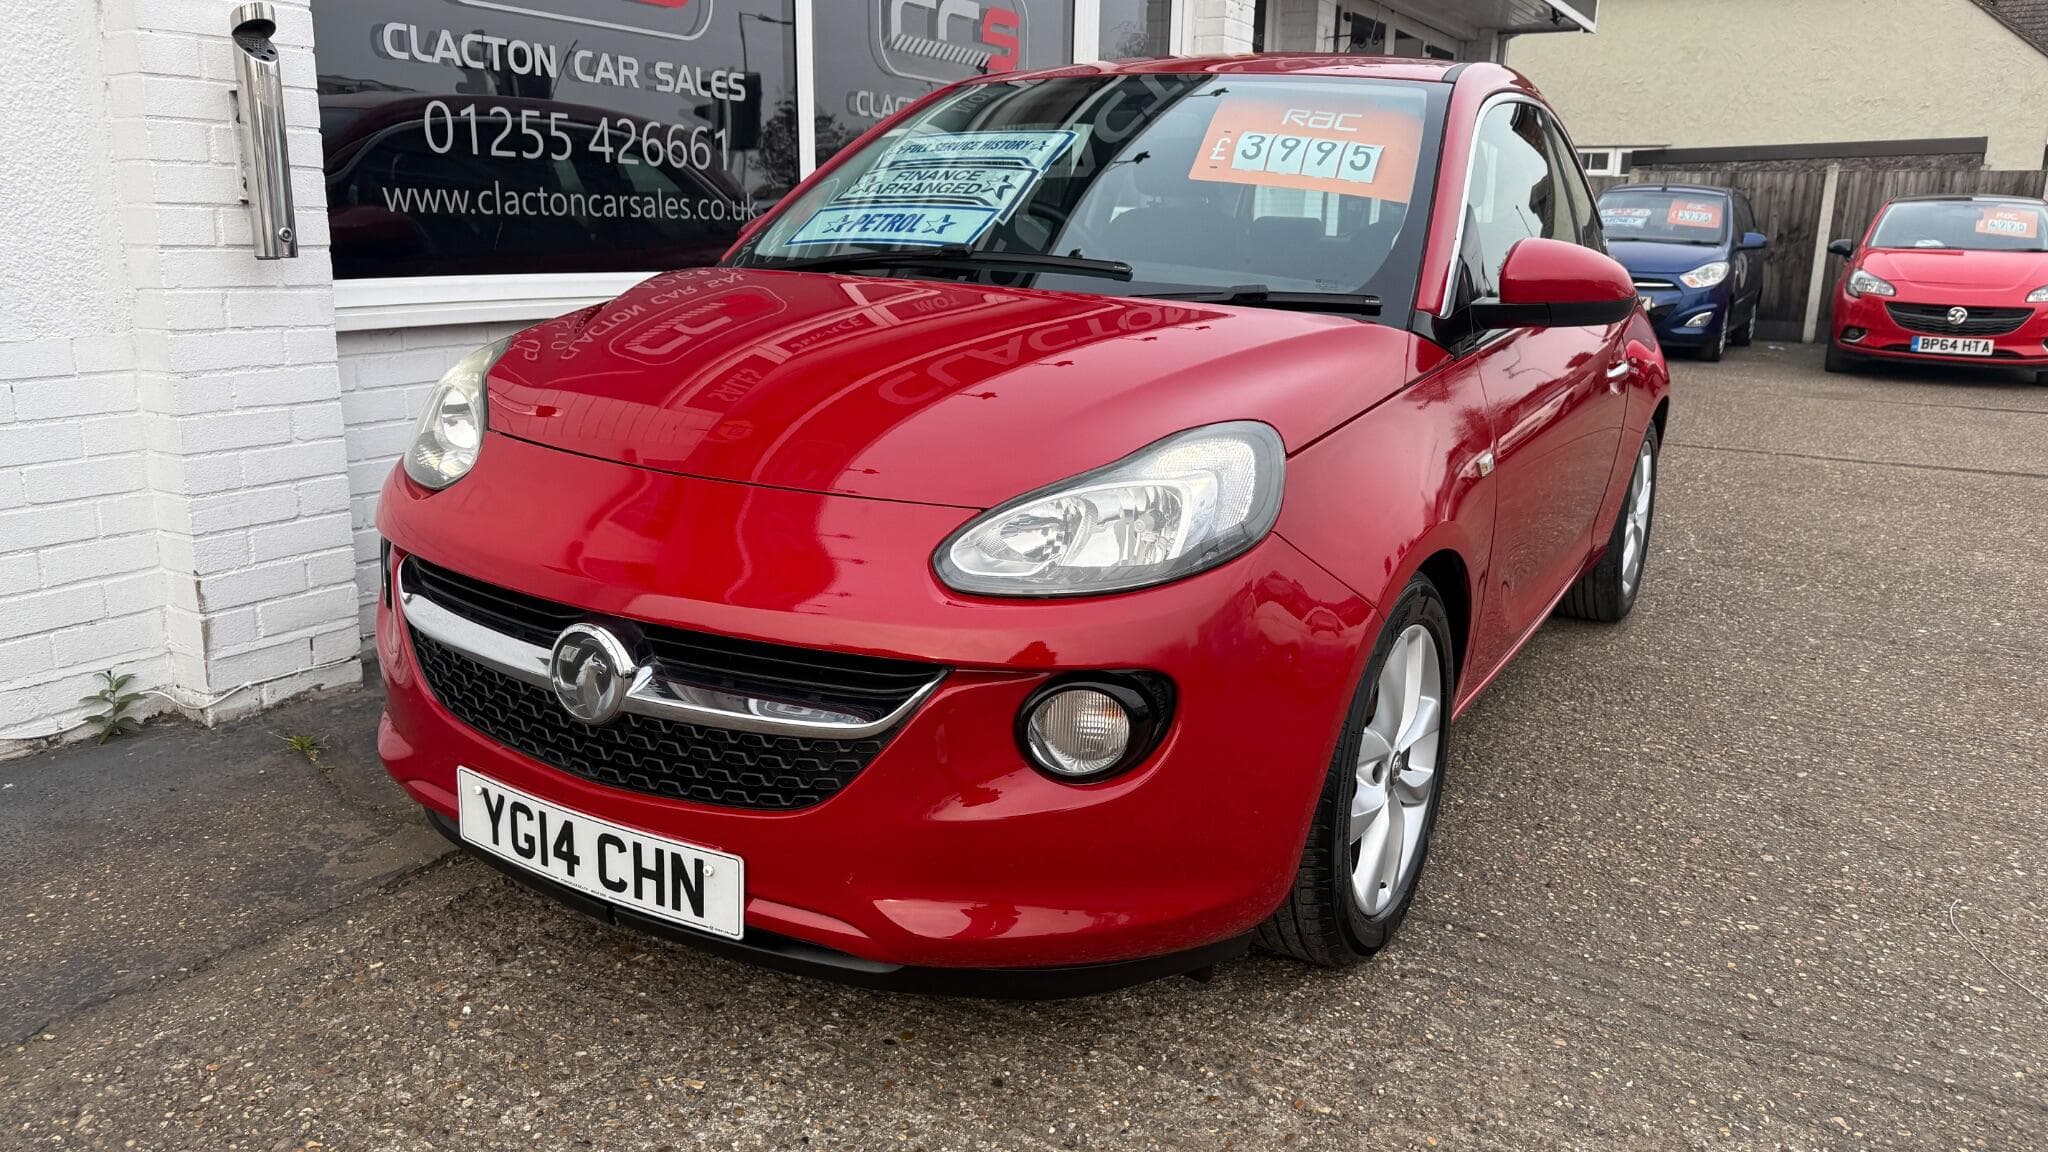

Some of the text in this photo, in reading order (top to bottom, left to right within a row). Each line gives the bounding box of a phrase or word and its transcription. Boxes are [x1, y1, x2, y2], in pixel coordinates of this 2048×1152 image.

[383, 22, 746, 101] CLACTON CAR SALES
[424, 100, 730, 171] 01255 426661
[905, 140, 1034, 154] FULL SERVICE HISTORY
[1241, 135, 1377, 171] 3995
[872, 182, 983, 195] ARRANGED
[892, 170, 986, 182] FINANCE
[382, 180, 759, 223] www.clactoncarsales.co.uk
[847, 213, 929, 233] PETROL
[1920, 338, 1990, 353] BP64 HTA
[482, 787, 705, 918] YG14 CHN
